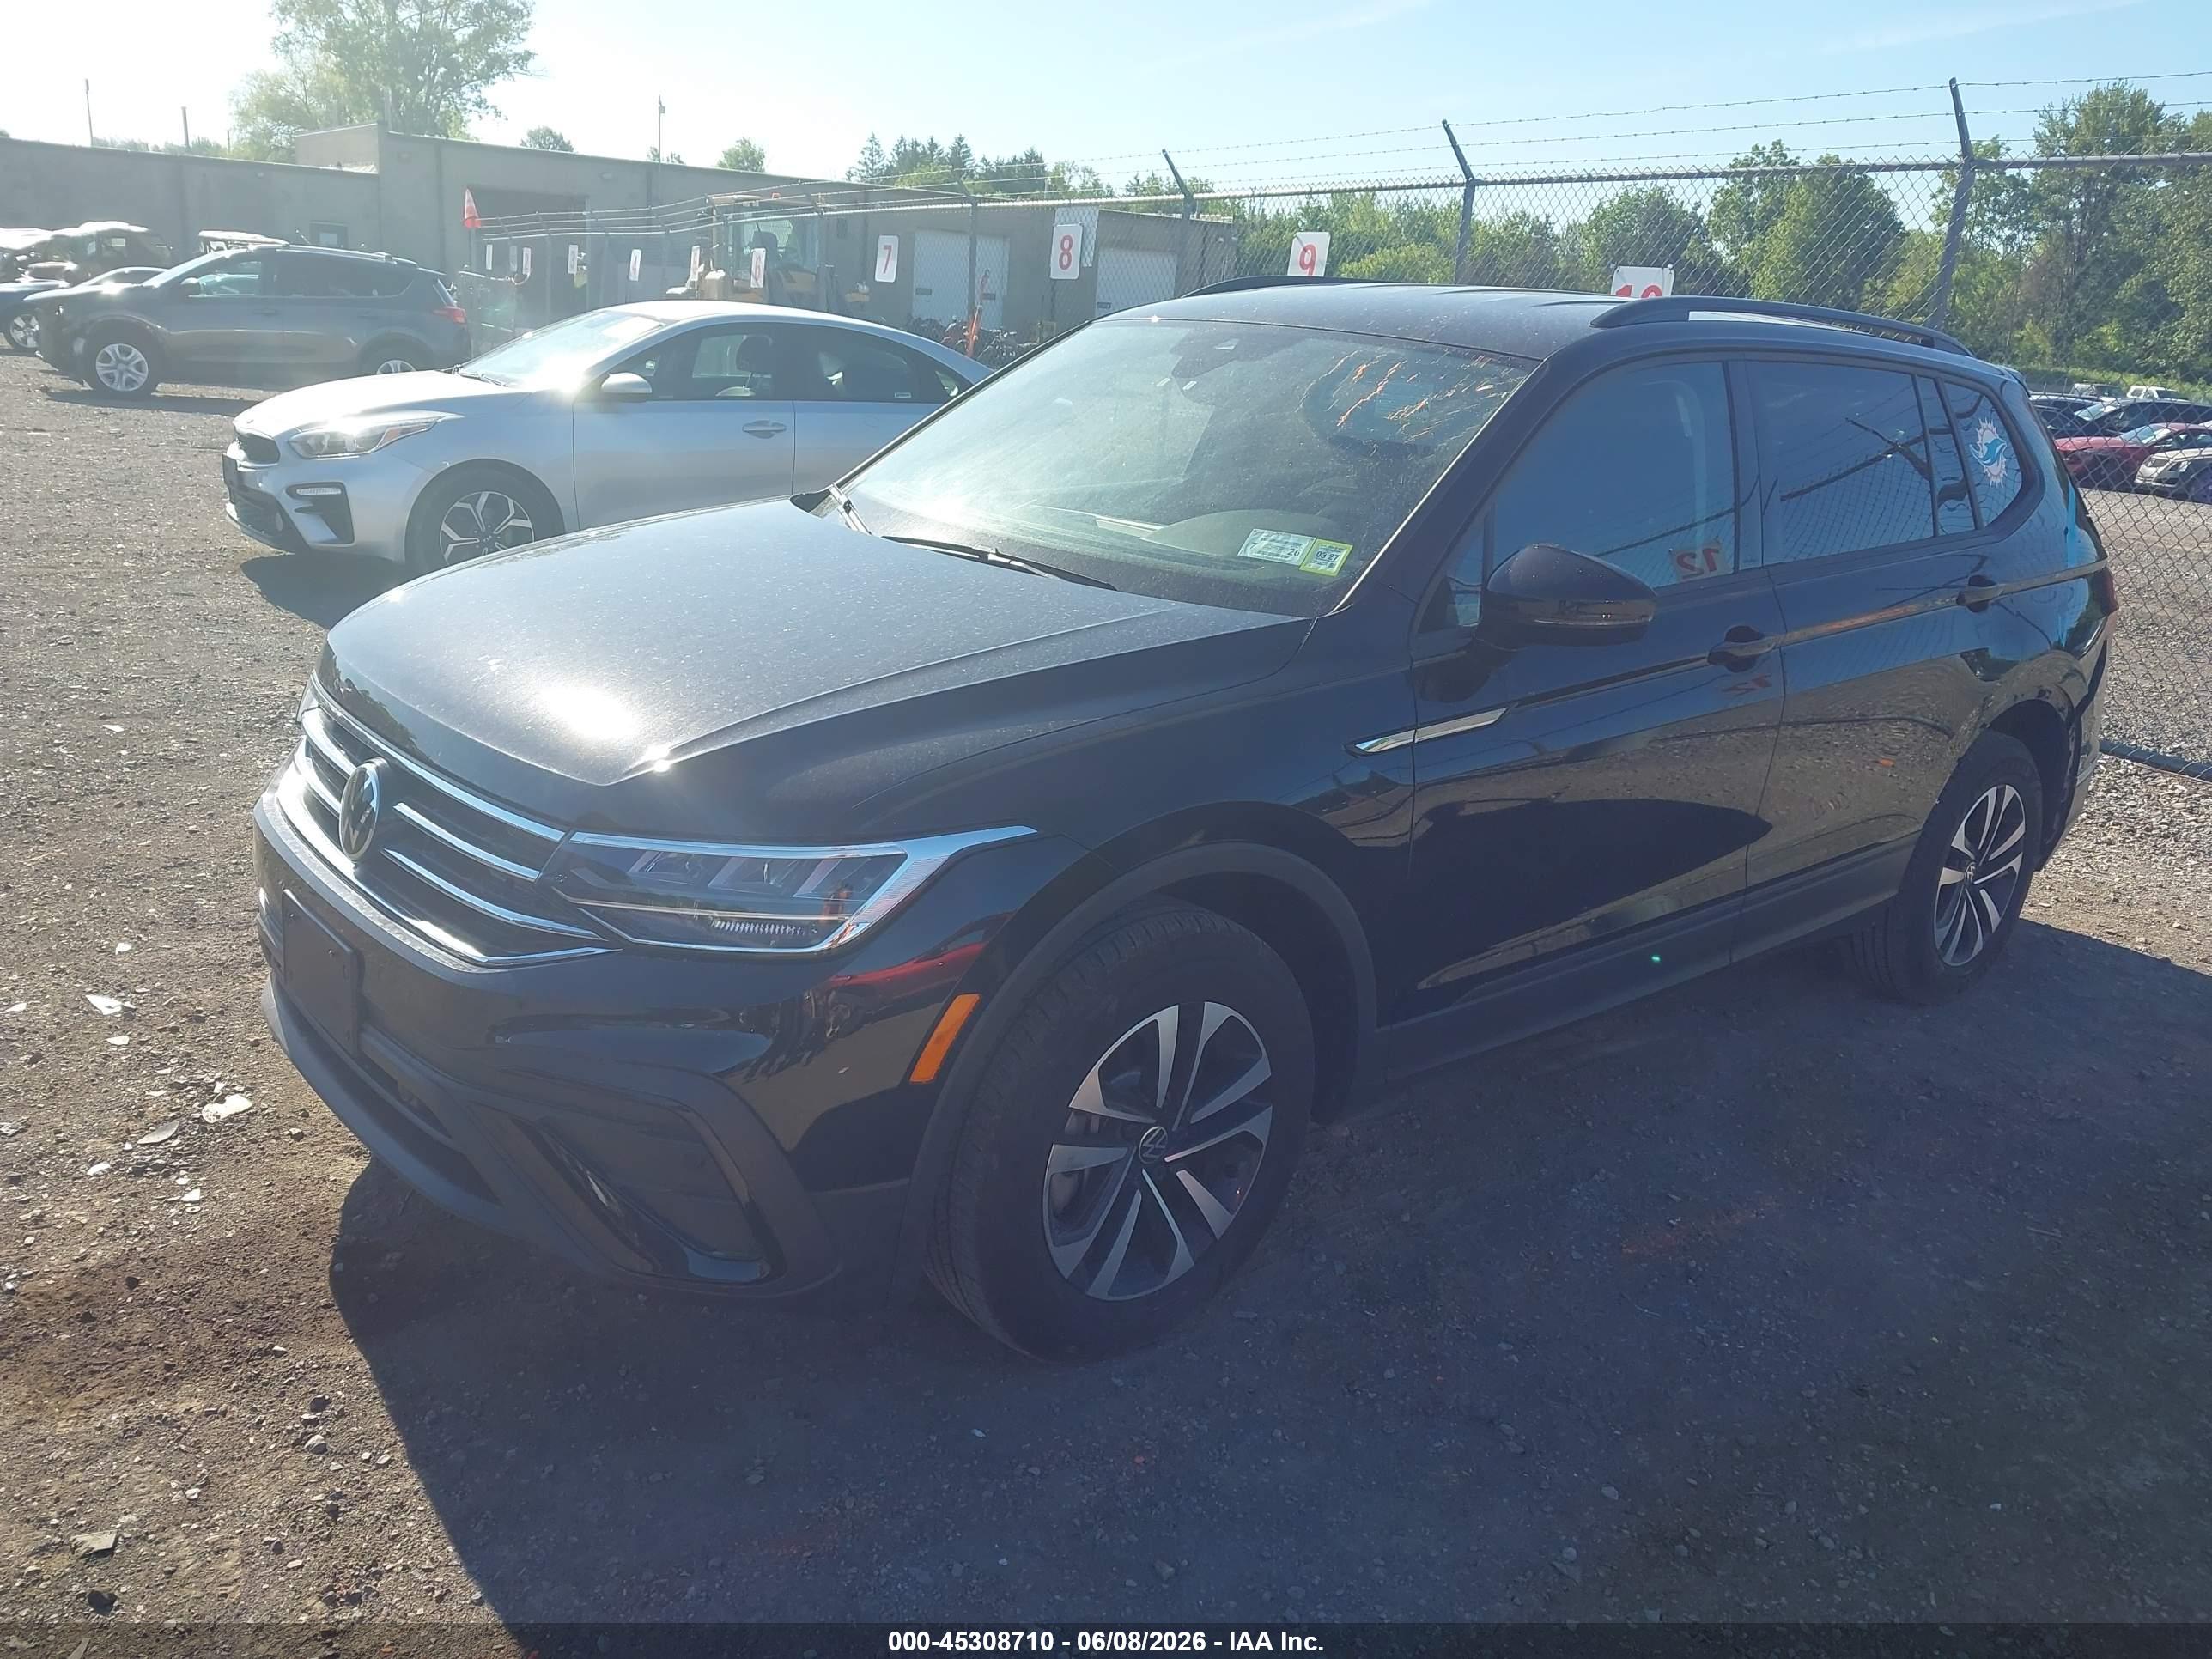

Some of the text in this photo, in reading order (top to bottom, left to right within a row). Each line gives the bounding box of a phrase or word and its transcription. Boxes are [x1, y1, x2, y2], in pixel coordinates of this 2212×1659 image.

[883, 244, 892, 274] 7
[1058, 234, 1073, 270] 8
[1299, 243, 1317, 276] 9
